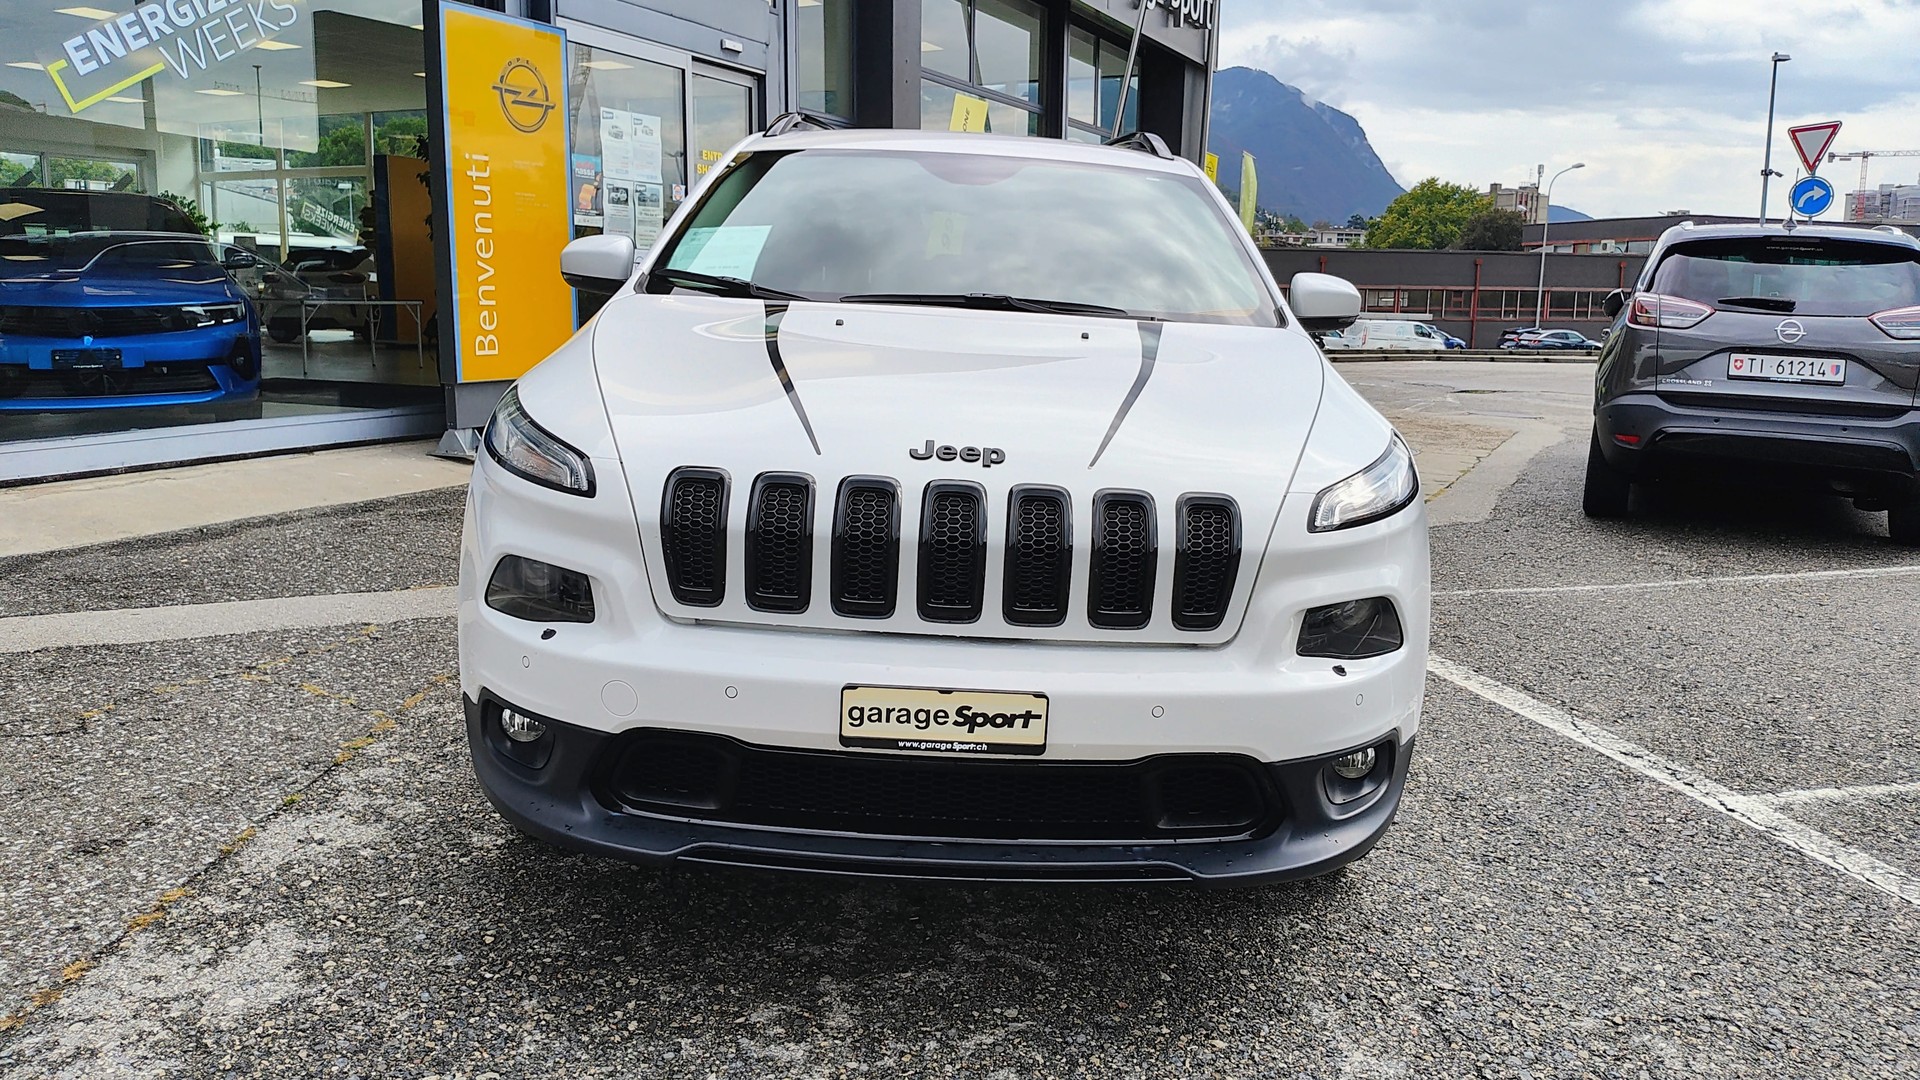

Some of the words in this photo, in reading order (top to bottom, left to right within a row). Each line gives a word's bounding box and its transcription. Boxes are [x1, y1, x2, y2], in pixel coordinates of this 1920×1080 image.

[159, 0, 298, 80] WEEKS
[507, 57, 538, 73] OPEL
[465, 152, 499, 357] Benvenuti
[1748, 358, 1764, 373] TI
[1776, 360, 1826, 377] 61214
[909, 440, 1006, 468] Jeep
[848, 705, 950, 730] garage
[952, 705, 1042, 733] Sport
